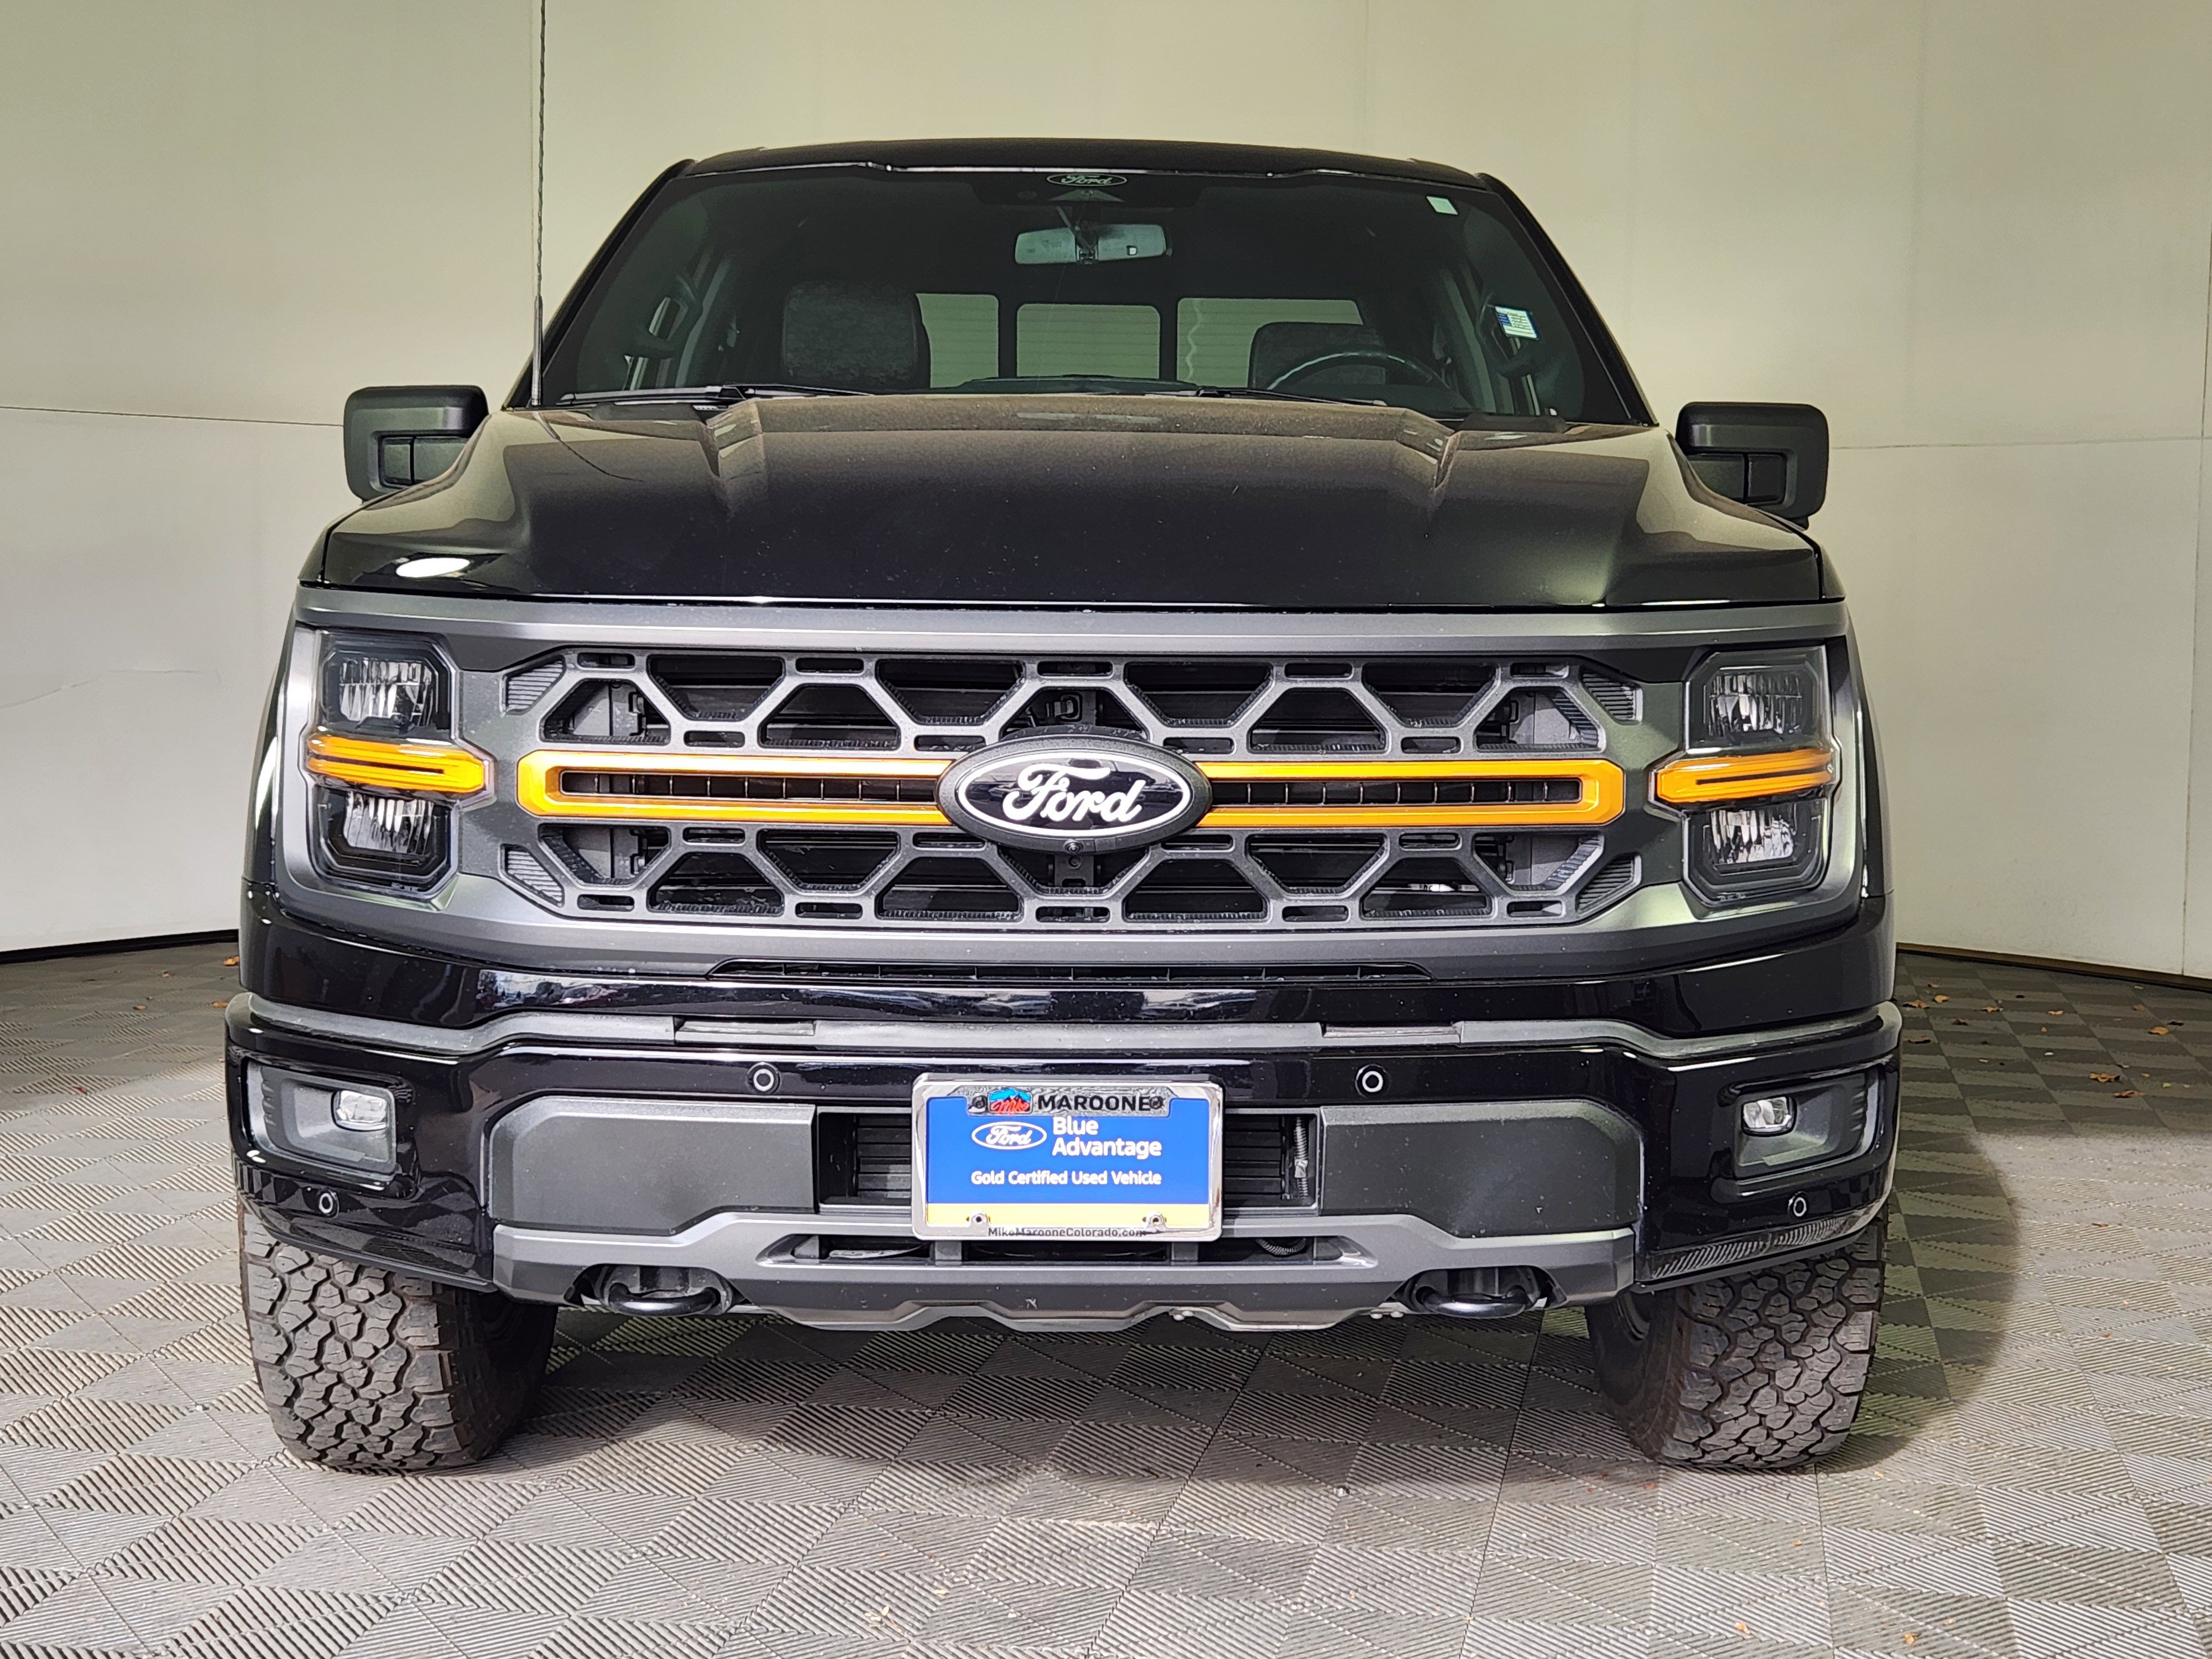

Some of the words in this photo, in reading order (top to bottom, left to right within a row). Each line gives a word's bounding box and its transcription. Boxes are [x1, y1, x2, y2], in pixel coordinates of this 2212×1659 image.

[1061, 175, 1113, 185] Ford
[1003, 764, 1146, 822] Ford
[1038, 1095, 1151, 1111] MAROONE
[1053, 1117, 1099, 1135] Blue
[985, 1125, 1032, 1146] Ford
[1052, 1137, 1162, 1160] Advantage
[971, 1171, 1005, 1185] Gold
[1009, 1171, 1068, 1185] Certified
[1072, 1171, 1108, 1185] Used
[1110, 1171, 1162, 1185] Vehicle
